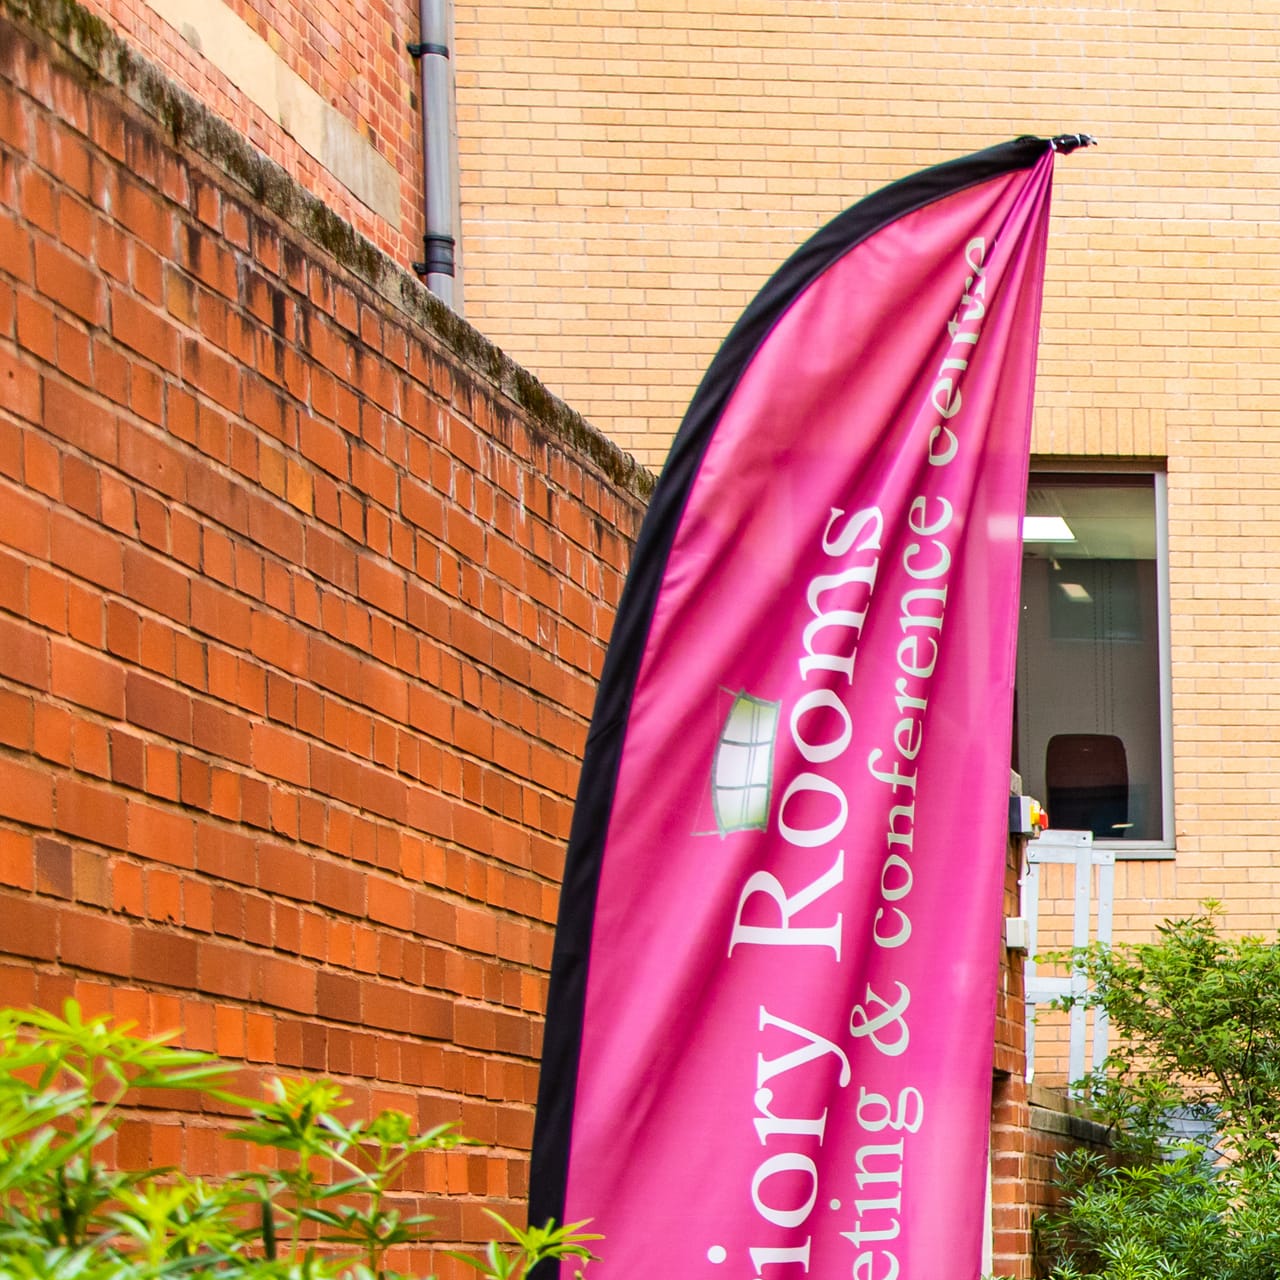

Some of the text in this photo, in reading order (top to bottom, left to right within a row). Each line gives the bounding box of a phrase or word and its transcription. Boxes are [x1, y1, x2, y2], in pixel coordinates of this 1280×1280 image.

[927, 236, 988, 467] centre
[727, 505, 885, 963] Rooms
[868, 494, 955, 948] conference
[849, 981, 911, 1057] &
